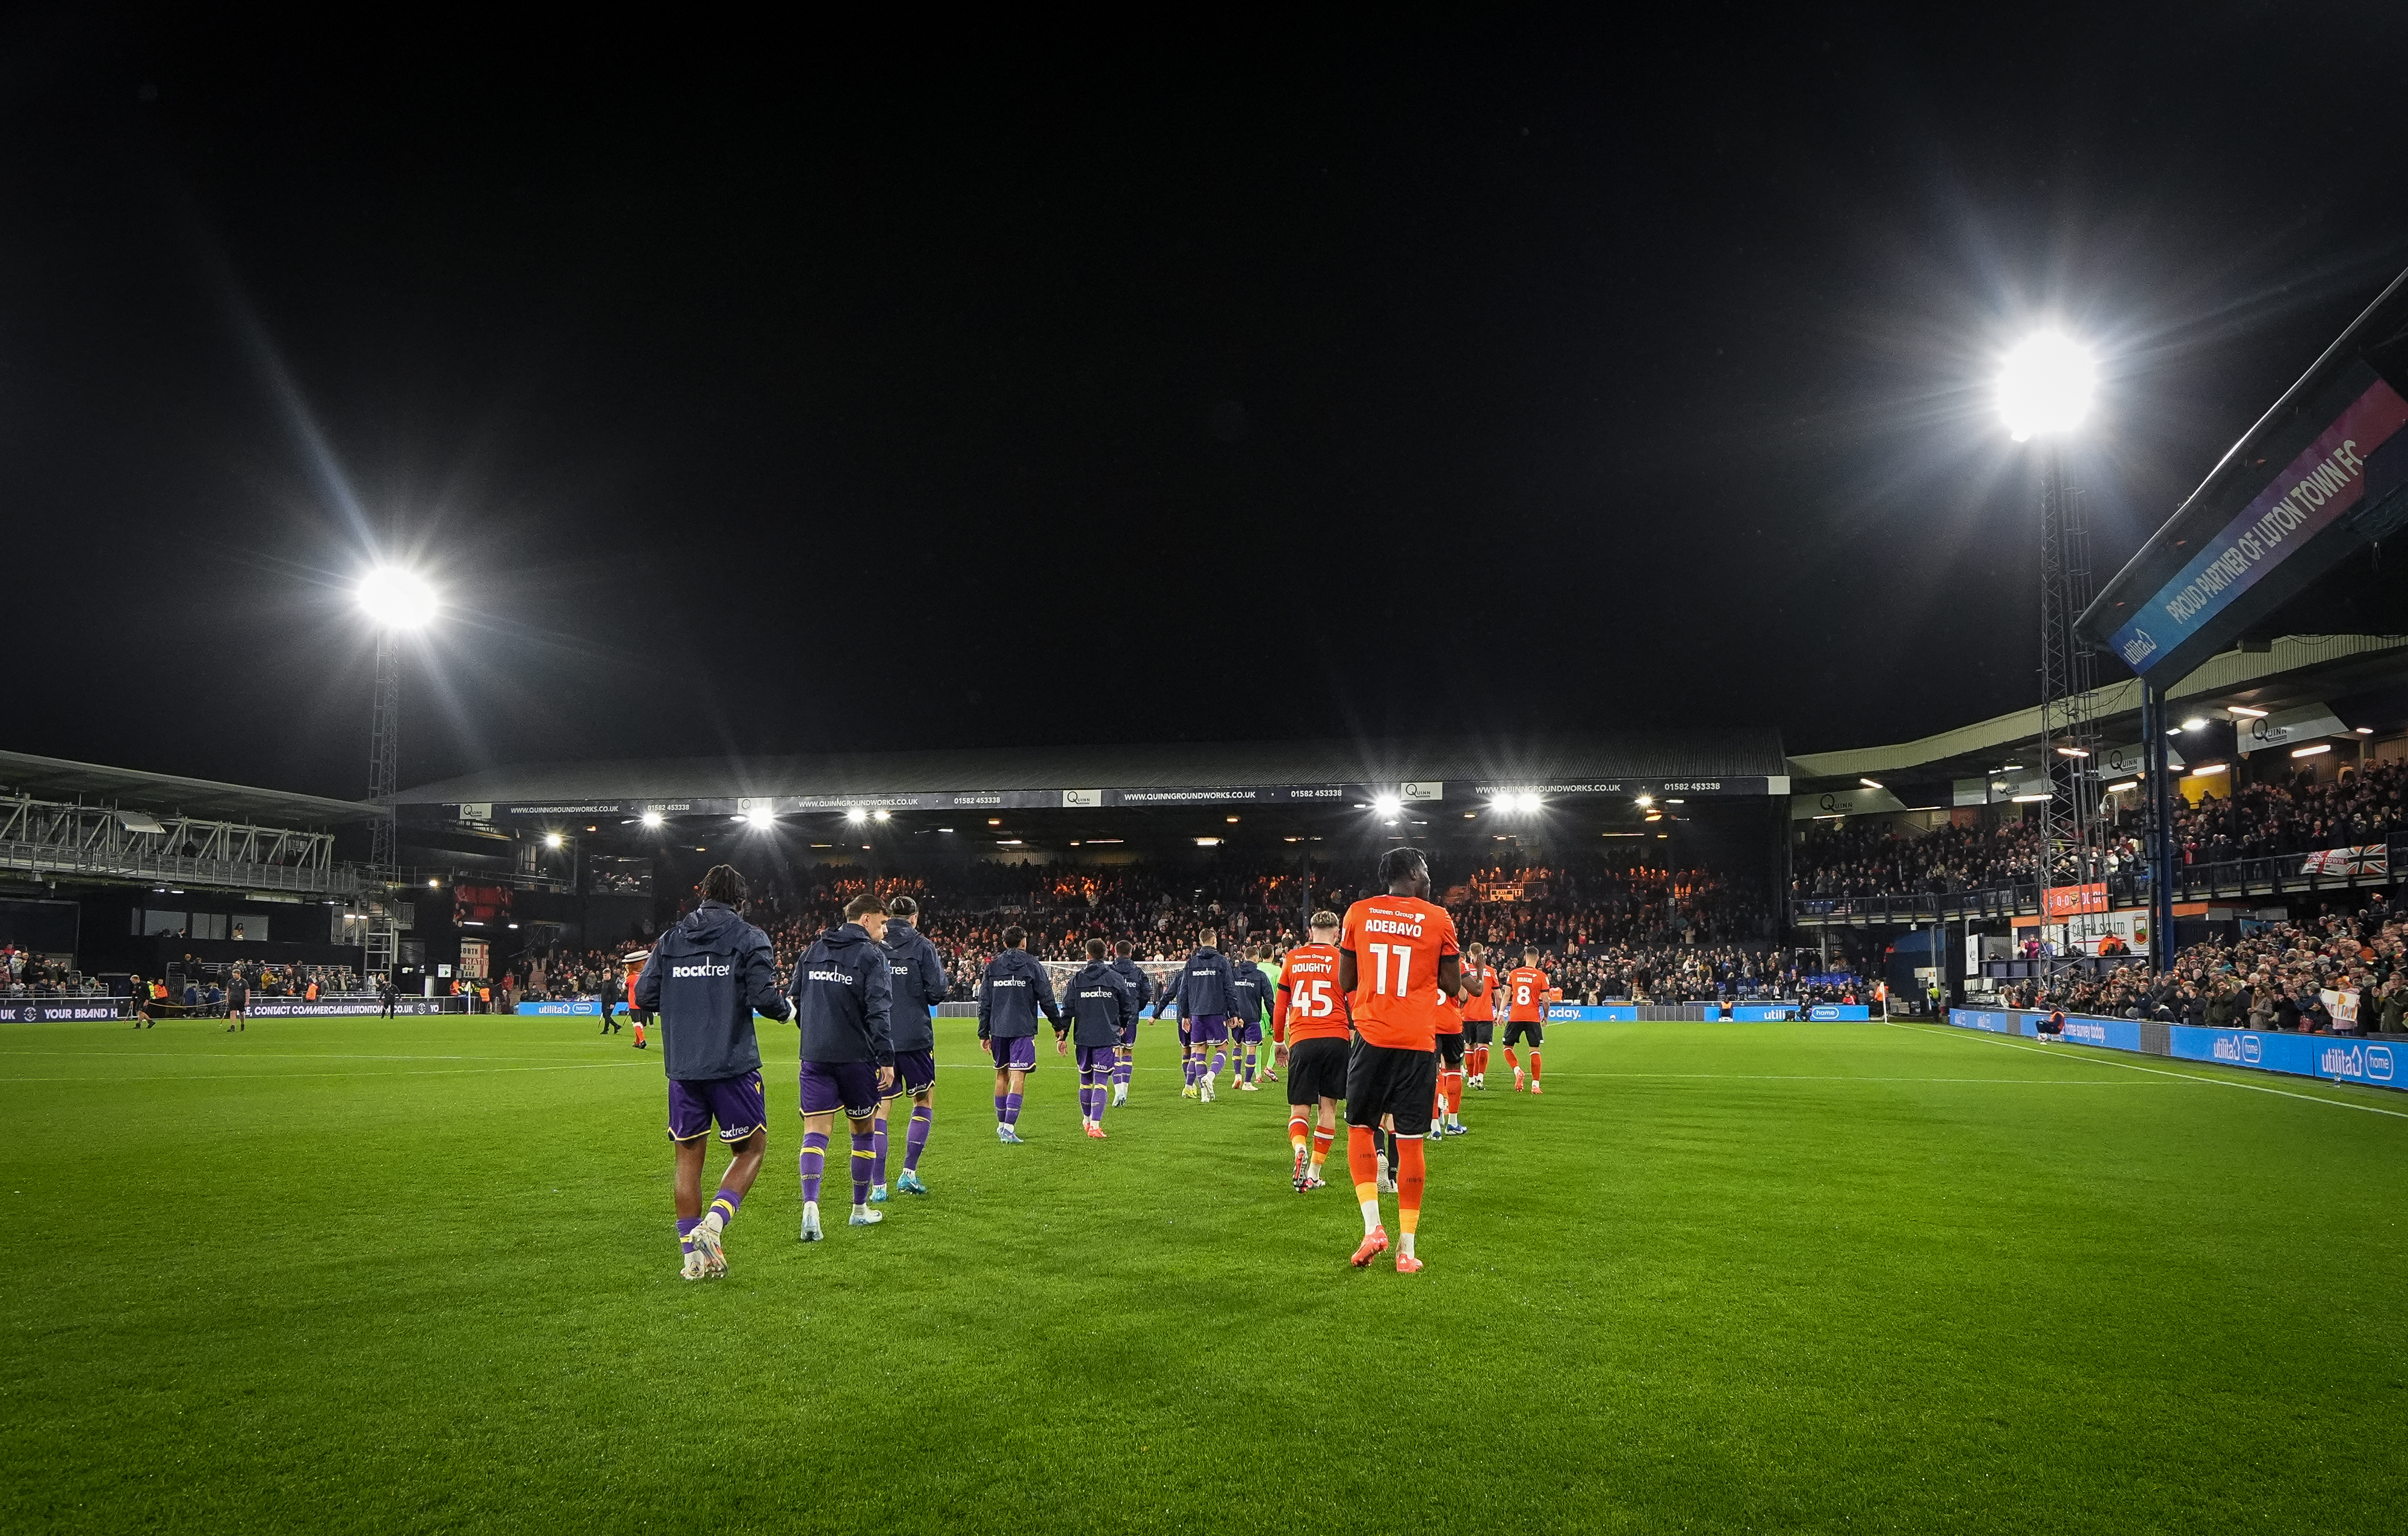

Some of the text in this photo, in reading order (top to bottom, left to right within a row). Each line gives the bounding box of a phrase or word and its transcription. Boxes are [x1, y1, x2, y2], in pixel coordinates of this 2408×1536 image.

[2165, 439, 2367, 624] PROUD PARTNER OF LUTON TOWN FC
[2123, 639, 2153, 665] utilita
[2110, 750, 2138, 772] QUINN
[1405, 784, 1431, 798] QUINN
[1476, 784, 1621, 793] WWW.QUINNGROUNDWORKS.CO.UK
[799, 797, 919, 808] WWW.QUINNGROUNDWORKS.CO.UK
[1067, 790, 1090, 804] QUINN
[1125, 791, 1256, 801] WWW.QUINNGROUNDWORKS.CO.UK
[510, 805, 618, 814] WWW.QUINNGROUNDWORKS.CO.UK
[1368, 907, 1414, 919] Toureen Group
[1365, 918, 1423, 938] ADEBAYO
[887, 960, 908, 975] tree
[1291, 962, 1332, 974] DOUGHTY
[1369, 943, 1412, 997] 11
[1291, 980, 1333, 1017] 45
[1516, 985, 1530, 1005] 8
[44, 1008, 72, 1020] YOUR
[74, 1008, 108, 1019] BRAND
[254, 1005, 291, 1016] CONTACT
[538, 1005, 562, 1014] utilita
[1548, 1007, 1581, 1020] oday.
[1764, 1009, 1786, 1020] utili
[2214, 1038, 2258, 1060] utilita home
[2321, 1048, 2390, 1075] utilita home
[847, 1105, 872, 1116] CKtree
[721, 1123, 749, 1138] CKtree
